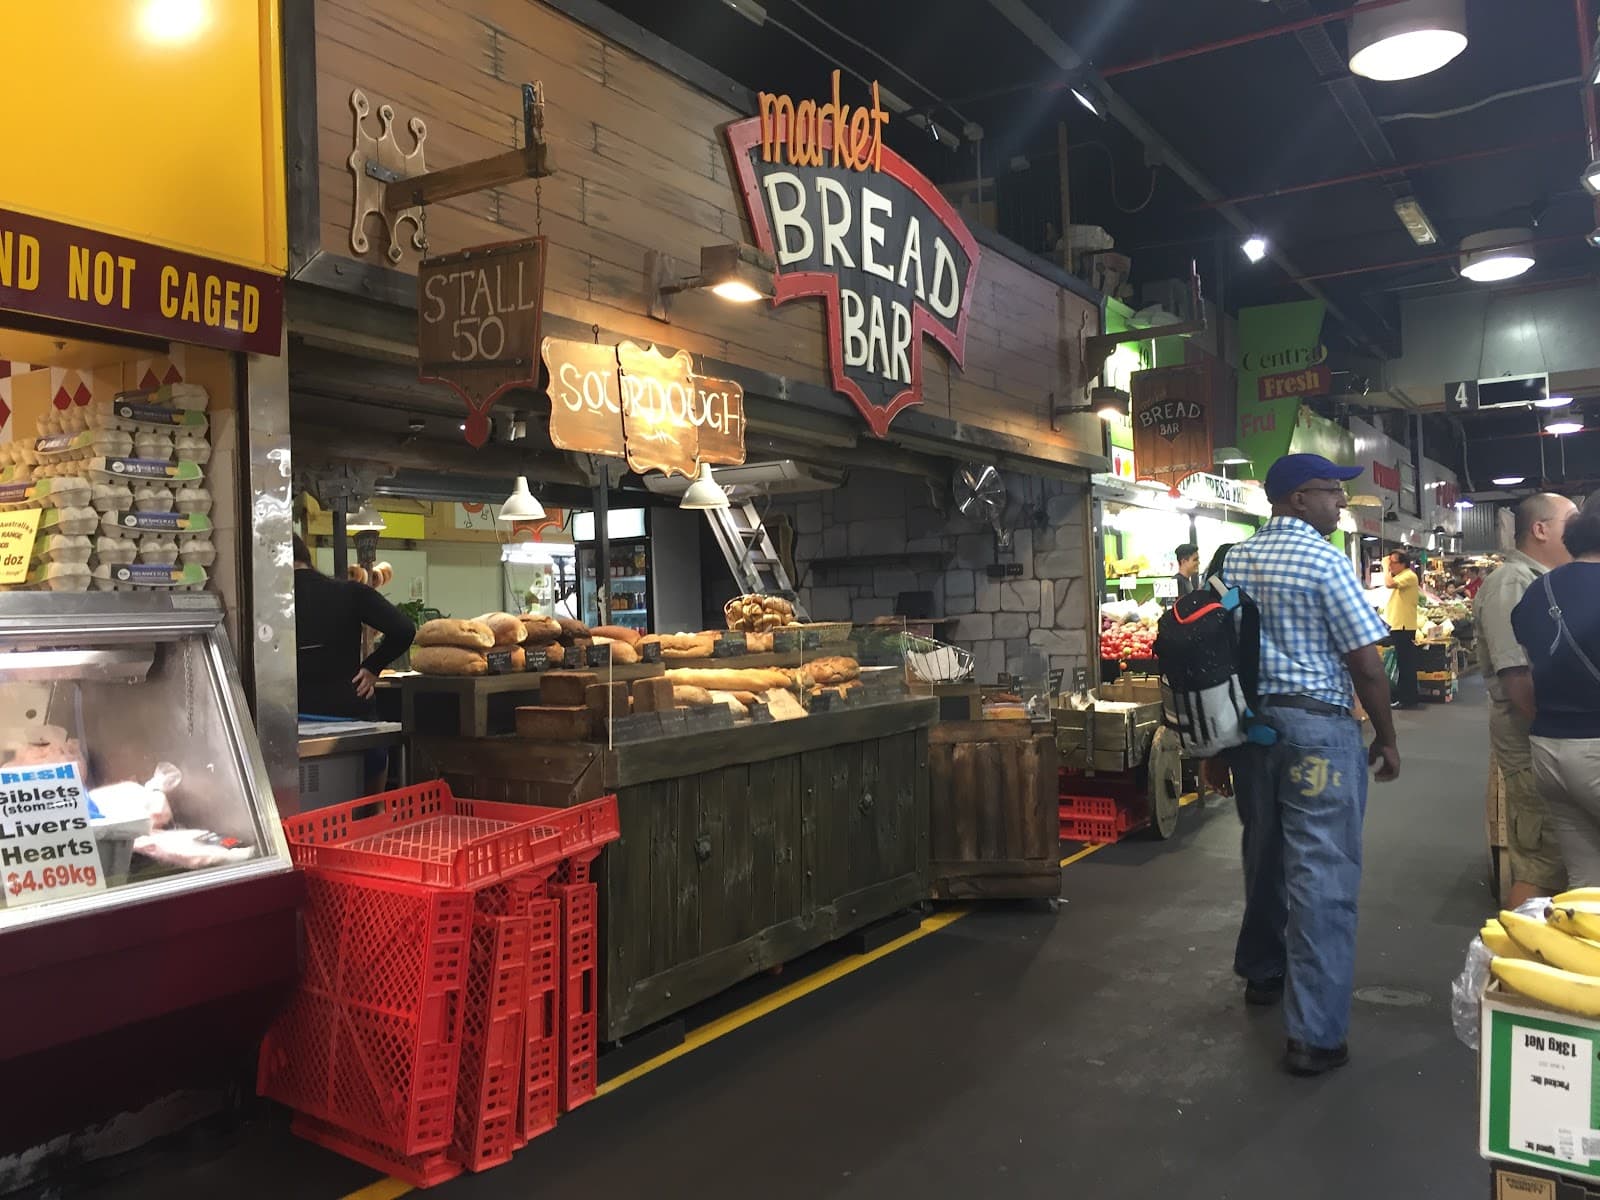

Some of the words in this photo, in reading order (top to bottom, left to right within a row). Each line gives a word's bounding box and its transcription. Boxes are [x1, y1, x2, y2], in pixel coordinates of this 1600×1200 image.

[758, 69, 889, 172] market
[763, 172, 959, 319] BREAD
[69, 245, 136, 310] NOT
[160, 264, 261, 334] CAGED
[423, 262, 534, 323] STALL
[452, 316, 505, 362] 50
[841, 289, 913, 385] BAR
[1263, 370, 1320, 398] Fresh
[1454, 382, 1468, 409] 4
[560, 363, 742, 435] SOURDOUGH
[1139, 401, 1201, 428] BREAD
[1159, 423, 1180, 436] BAR
[4, 554, 24, 566] doz
[1, 763, 74, 785] RESH
[0, 816, 87, 840] Livers
[2, 838, 93, 867] Hearts
[7, 863, 97, 896] $4.69kg
[1524, 1033, 1545, 1051] Net
[1548, 1037, 1578, 1058] 13kg
